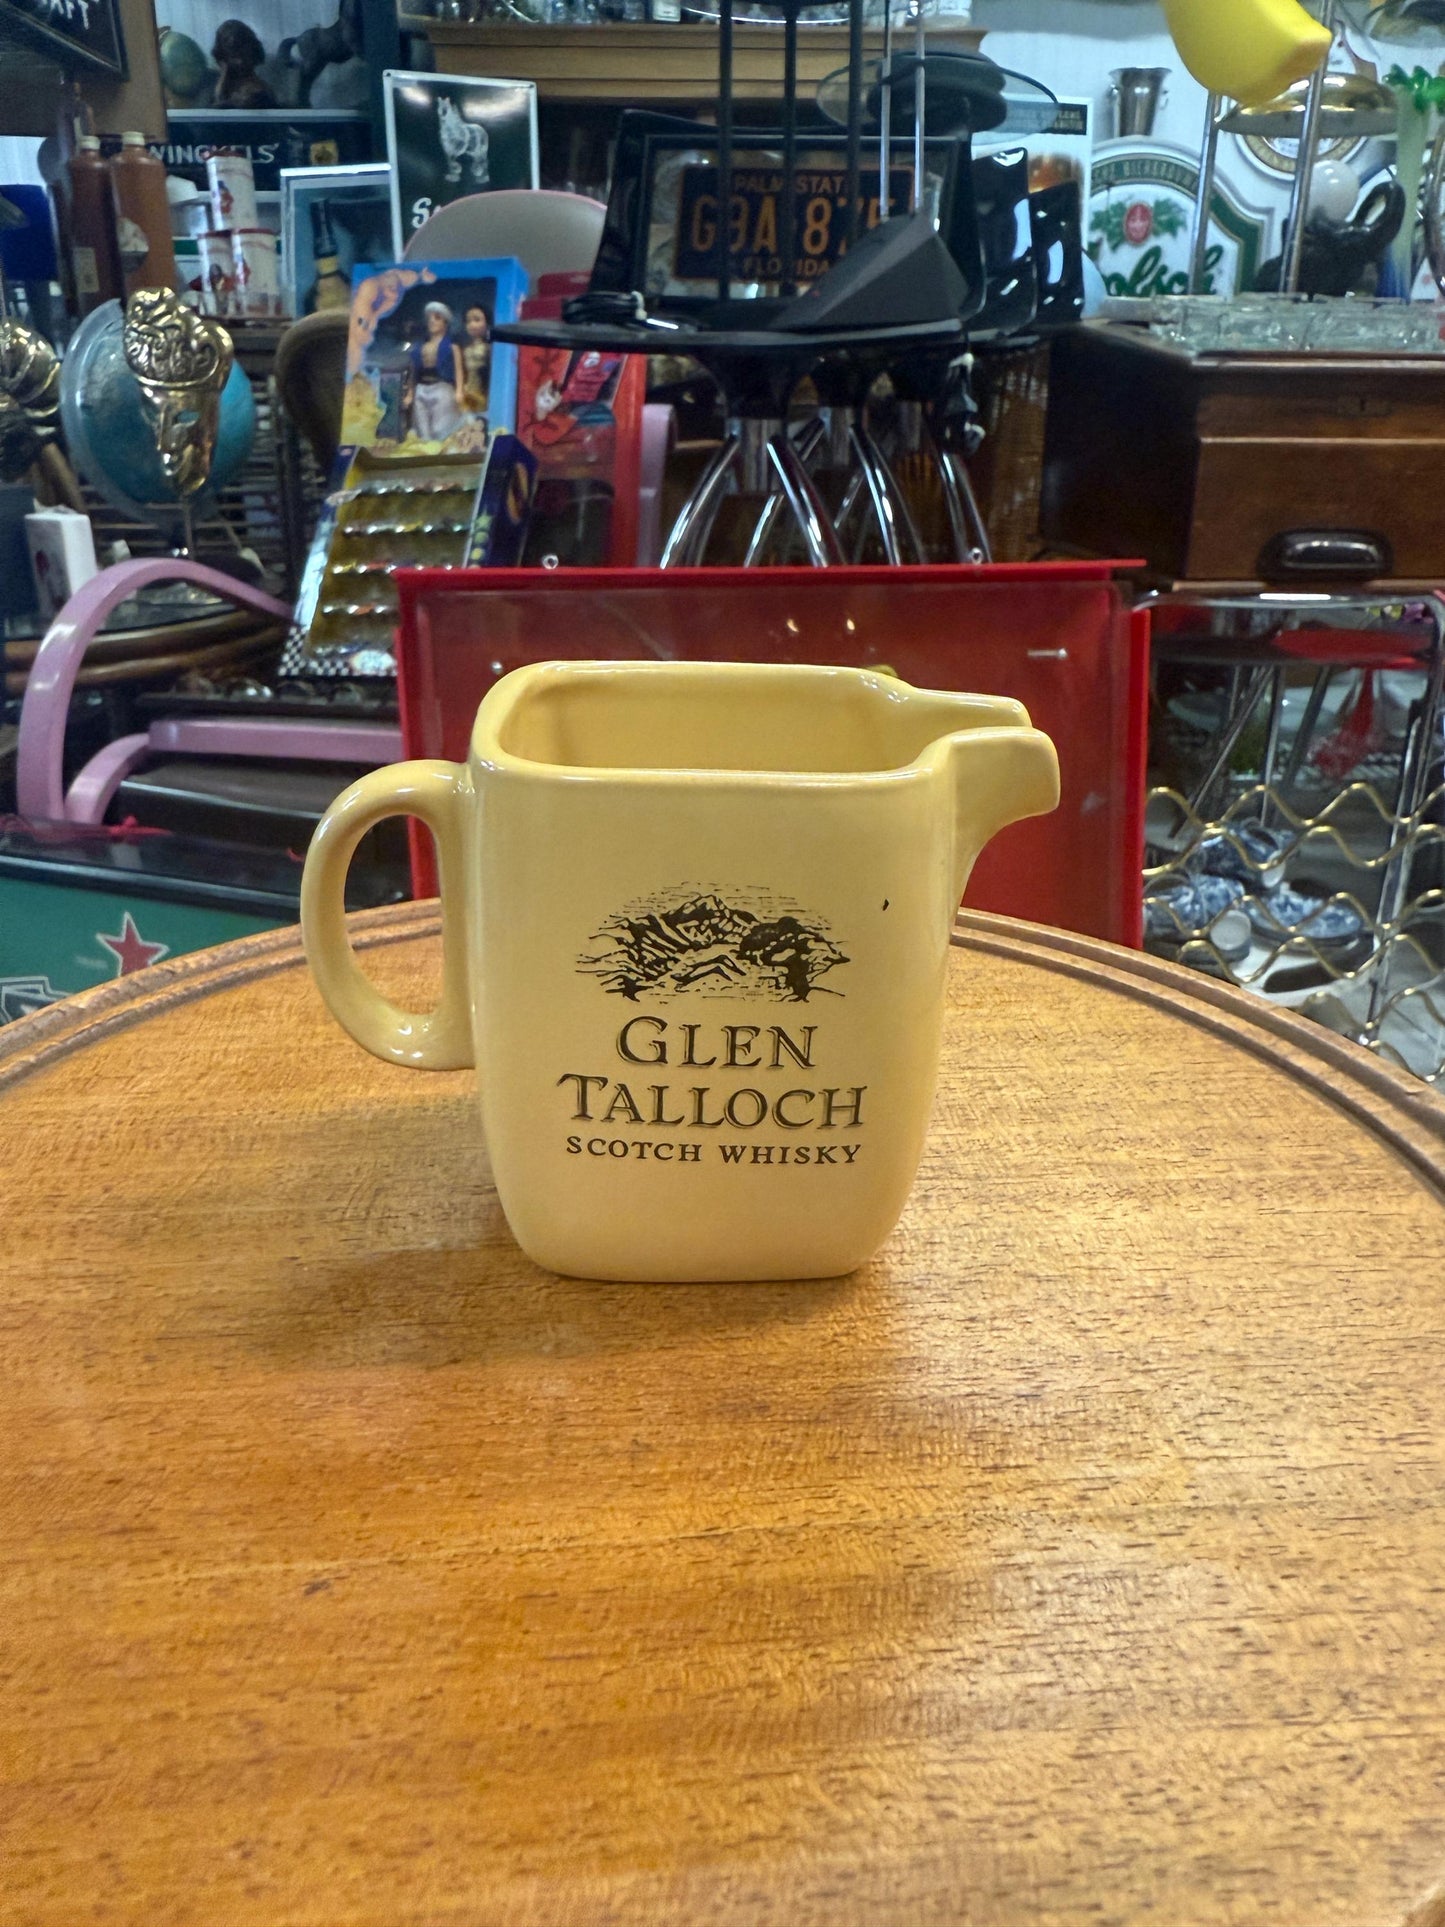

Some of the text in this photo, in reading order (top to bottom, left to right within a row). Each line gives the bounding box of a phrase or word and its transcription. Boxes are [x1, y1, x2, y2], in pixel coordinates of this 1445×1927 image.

[616, 1015, 818, 1070] GLEN
[557, 1073, 868, 1130] TALLOCH
[566, 1136, 862, 1165] SCOTCH WHISKY
